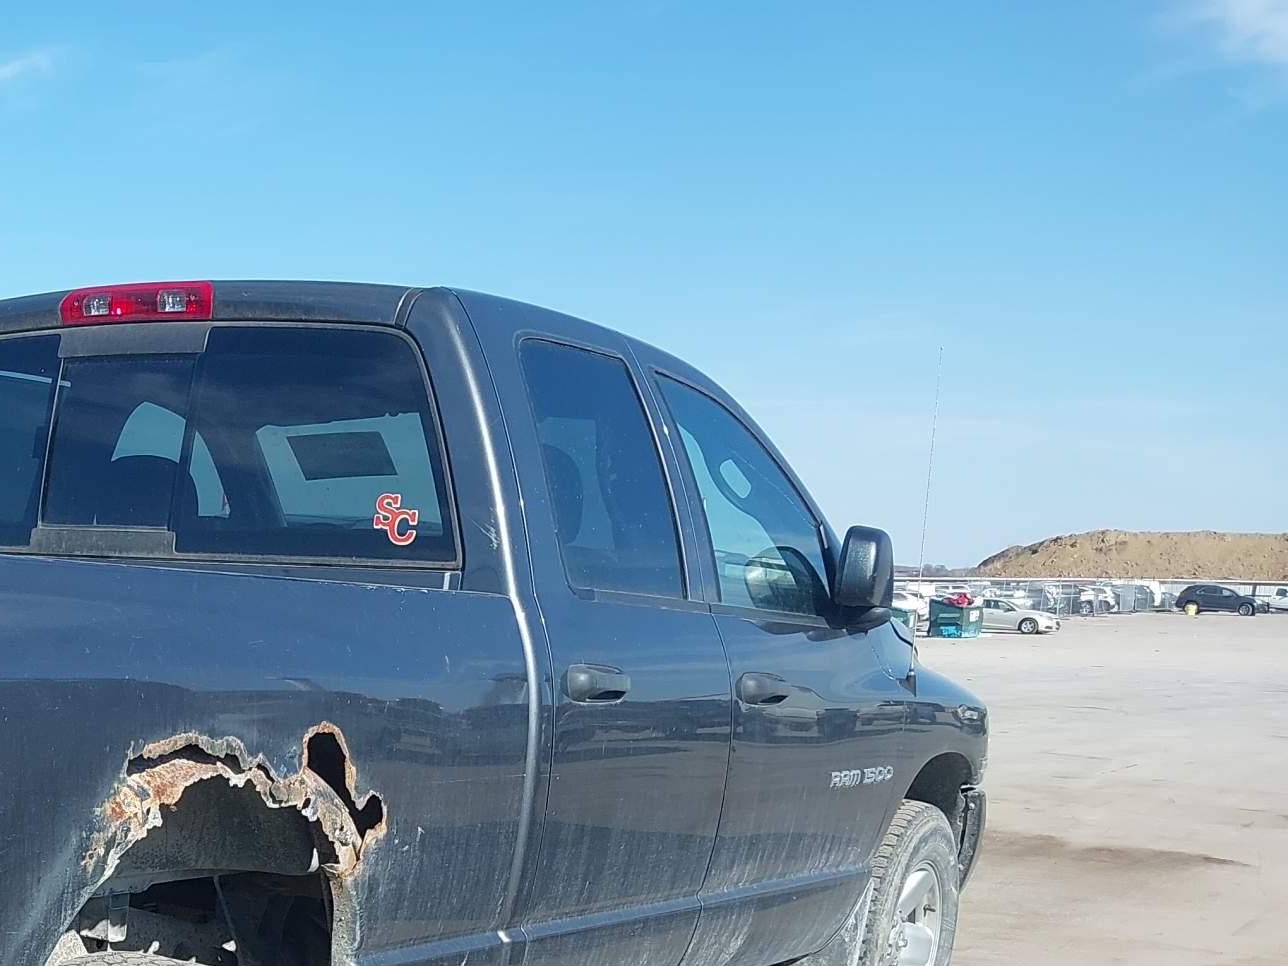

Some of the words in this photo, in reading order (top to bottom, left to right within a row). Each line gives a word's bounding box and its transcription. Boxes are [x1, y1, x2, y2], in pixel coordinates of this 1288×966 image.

[373, 493, 418, 545] SC
[829, 769, 861, 788] RAM
[863, 765, 894, 784] 1500
